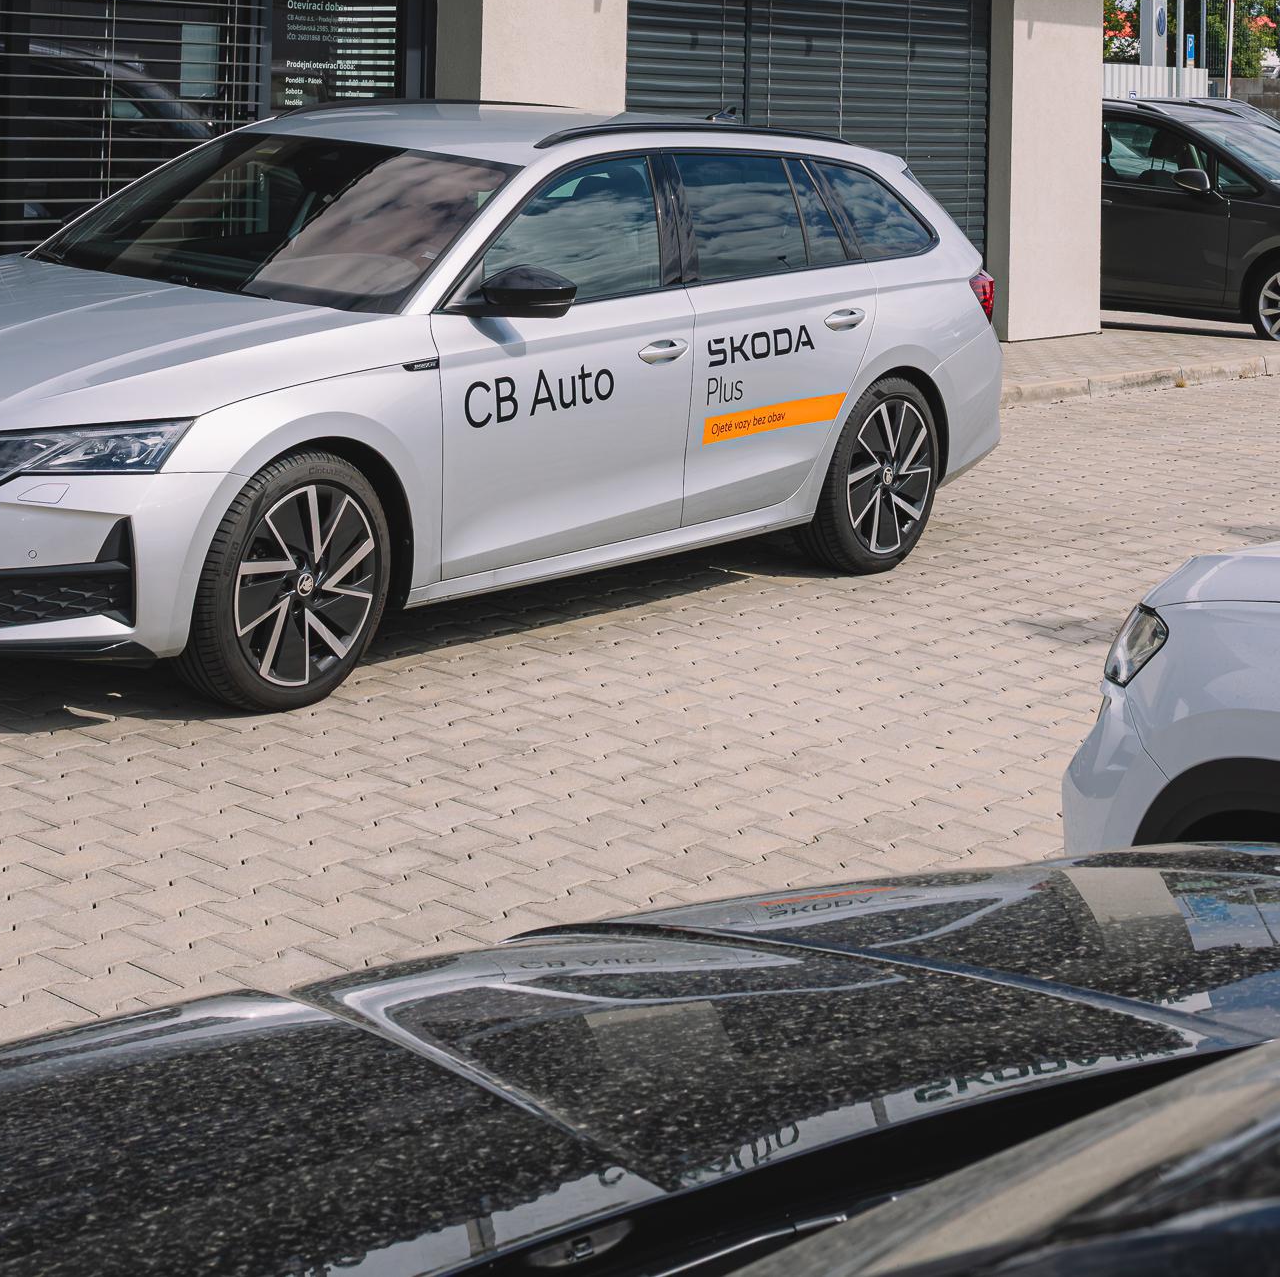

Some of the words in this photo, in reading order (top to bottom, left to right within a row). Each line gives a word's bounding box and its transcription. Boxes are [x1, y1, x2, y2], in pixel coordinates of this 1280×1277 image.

[1188, 38, 1193, 51] P
[286, 60, 312, 70] Prodejní
[285, 87, 303, 95] Sobota
[707, 325, 815, 367] SKODA
[464, 375, 519, 429] CB
[530, 363, 614, 417] Auto
[706, 376, 743, 406] Plus
[711, 422, 733, 436] Ojeté
[734, 419, 752, 431] vozy
[752, 415, 767, 426] bez
[767, 411, 786, 421] obav
